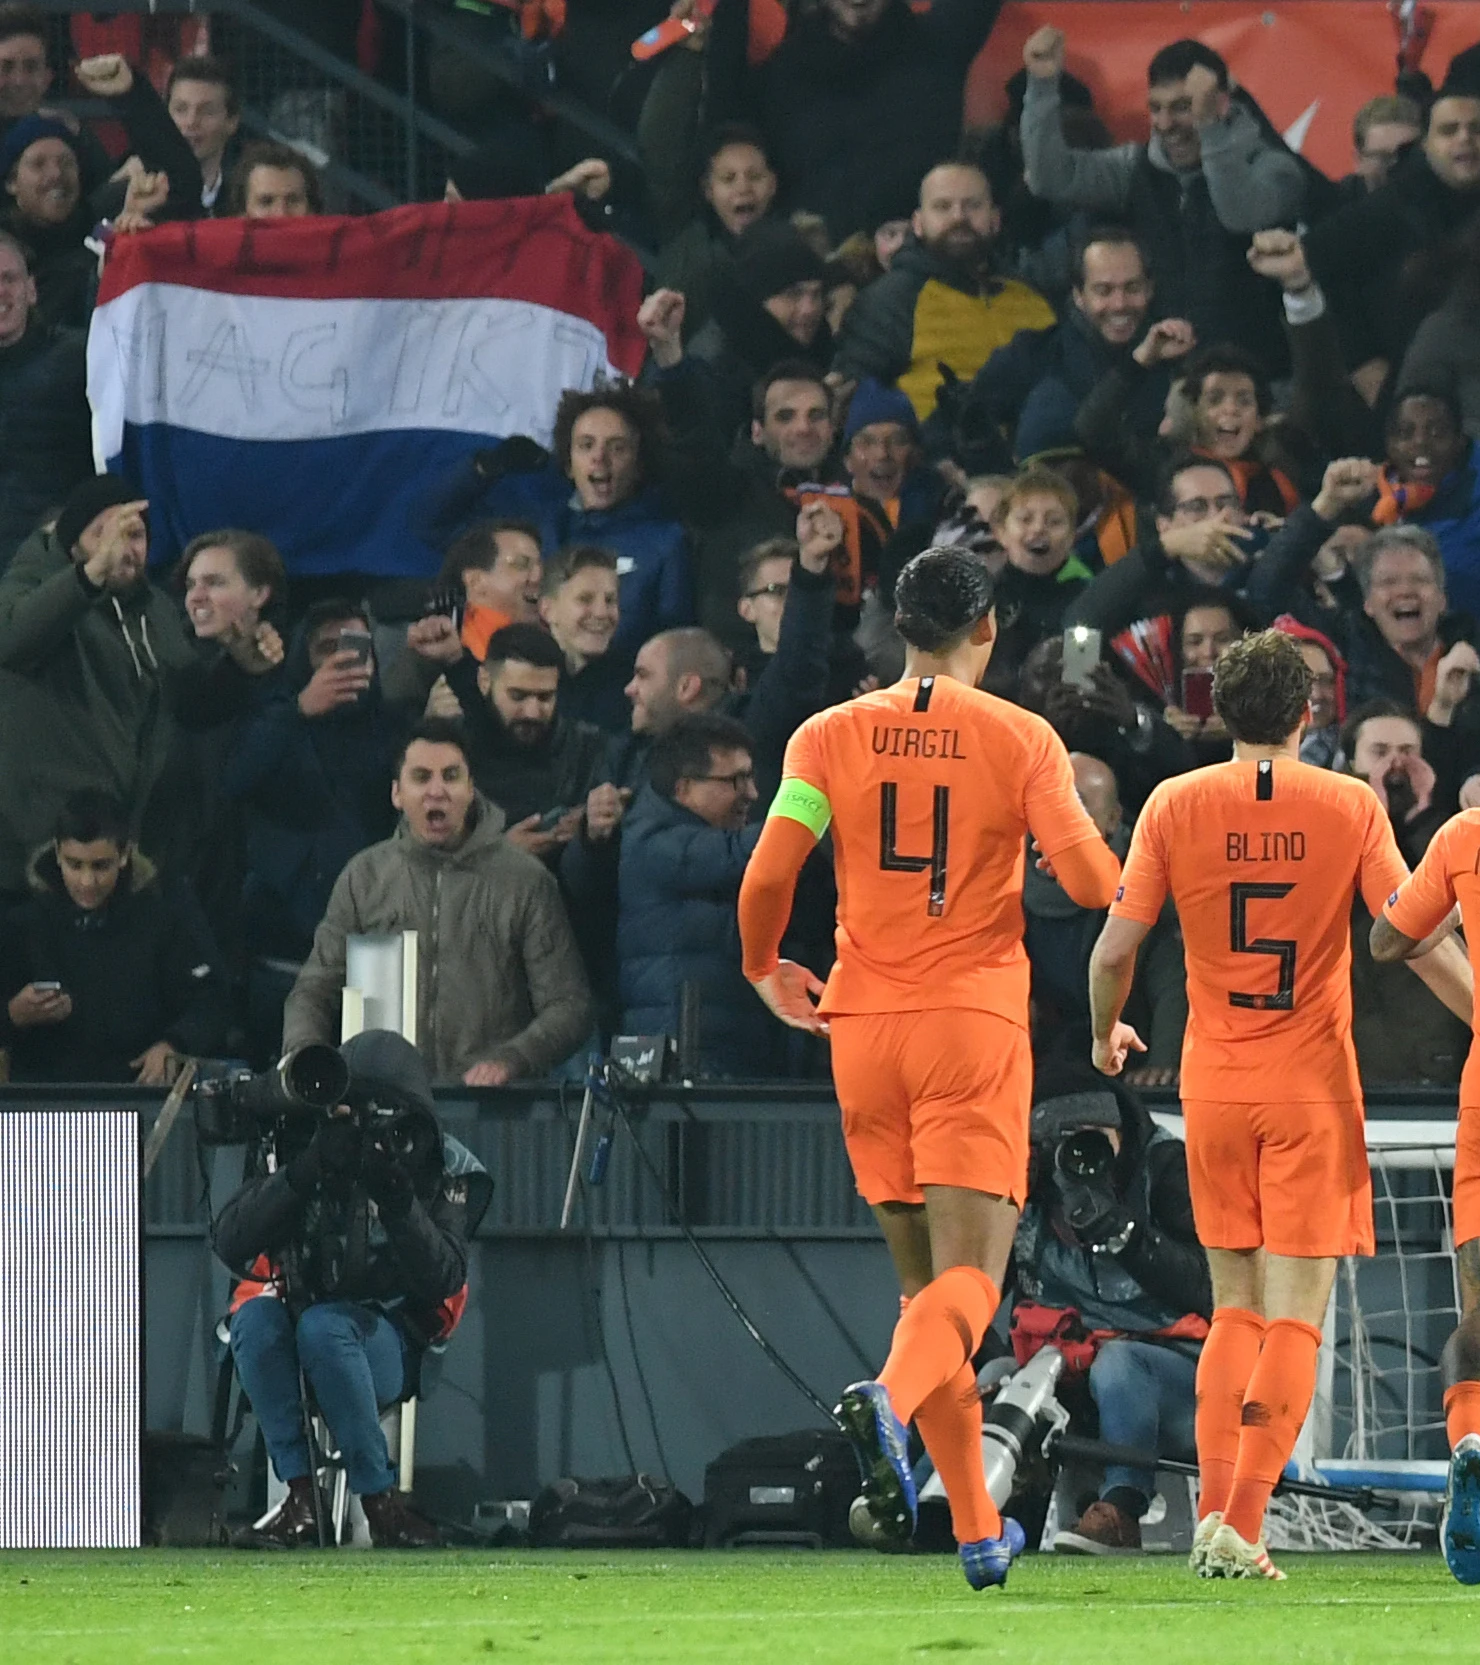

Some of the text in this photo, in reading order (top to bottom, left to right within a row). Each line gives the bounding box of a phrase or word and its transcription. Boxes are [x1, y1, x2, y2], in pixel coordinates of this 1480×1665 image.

[872, 726, 967, 760] VIRGIL
[880, 782, 950, 917] 4
[1226, 832, 1305, 862] BLIND
[1228, 882, 1298, 1011] 5
